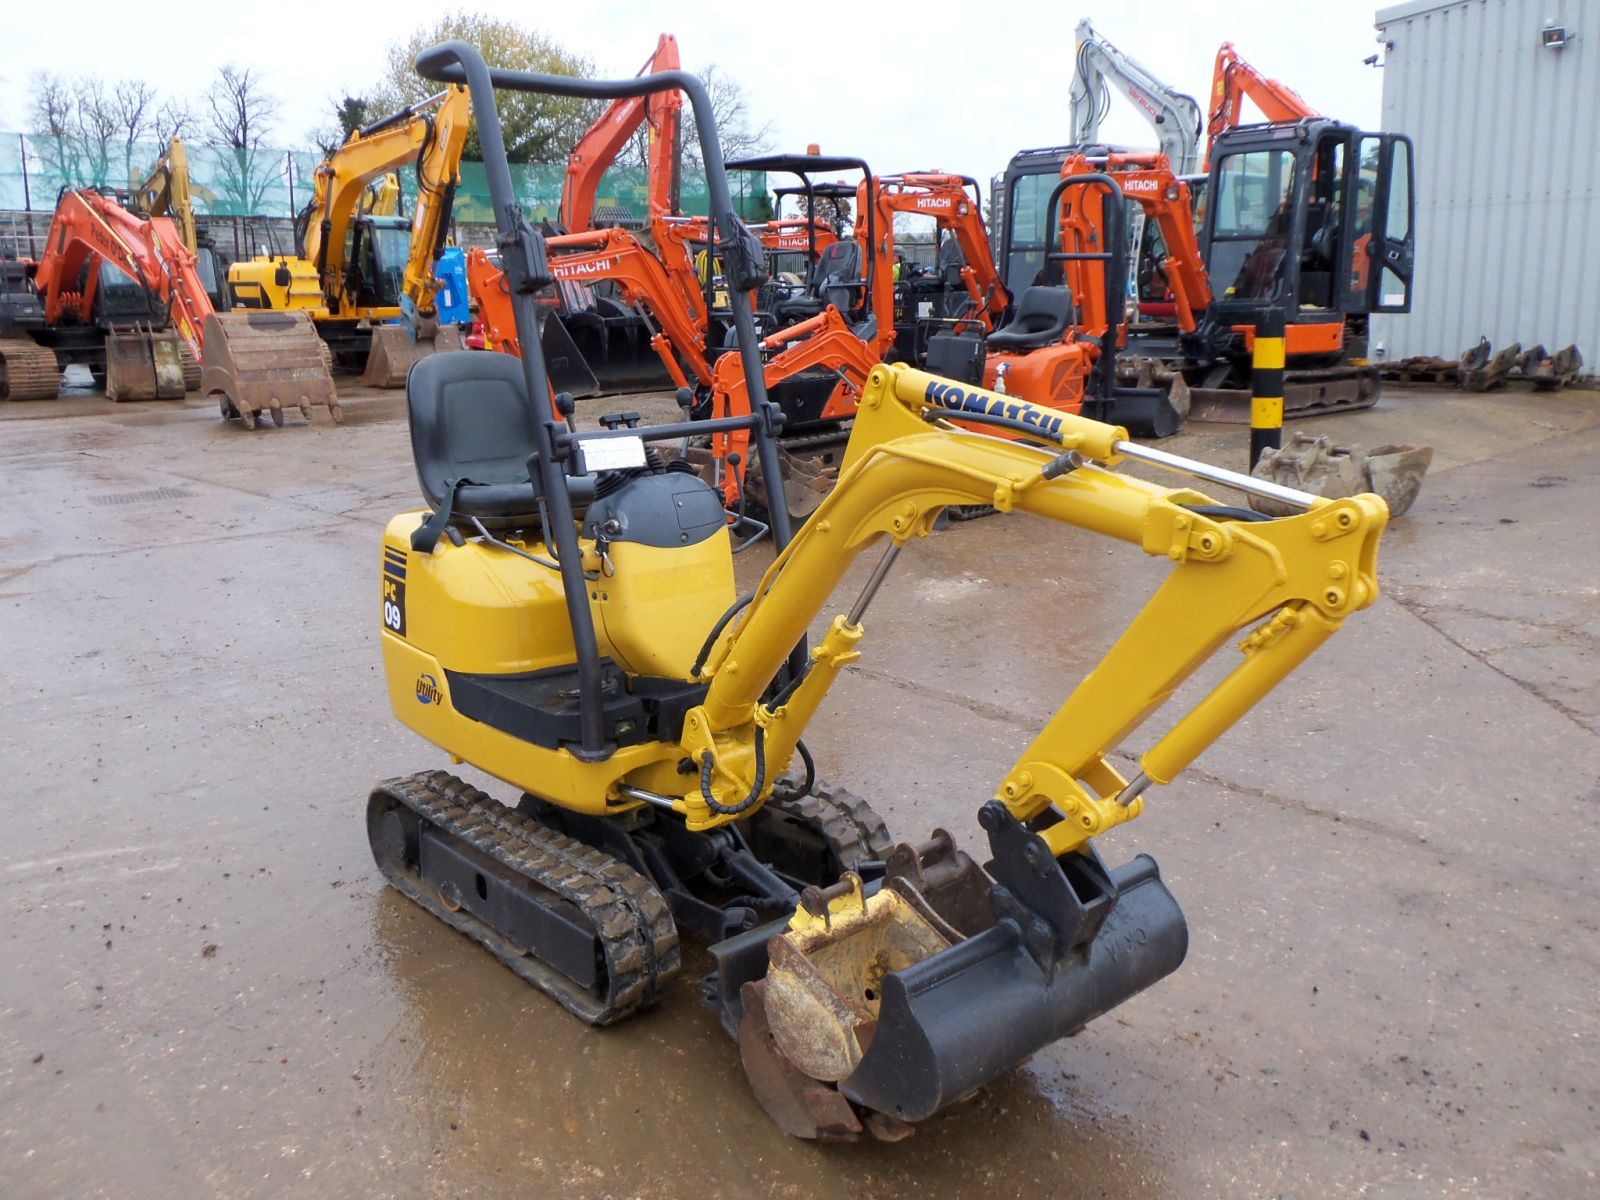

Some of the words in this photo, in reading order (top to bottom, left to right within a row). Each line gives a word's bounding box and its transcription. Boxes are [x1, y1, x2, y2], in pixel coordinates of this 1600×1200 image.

[1124, 179, 1158, 190] HITACHI
[917, 198, 951, 208] HITACHI
[778, 237, 810, 246] HITACH
[553, 258, 611, 277] HITACHI
[925, 380, 1064, 434] KOMATSU
[384, 580, 397, 602] PC
[384, 601, 401, 630] 09
[416, 678, 444, 706] Utility
